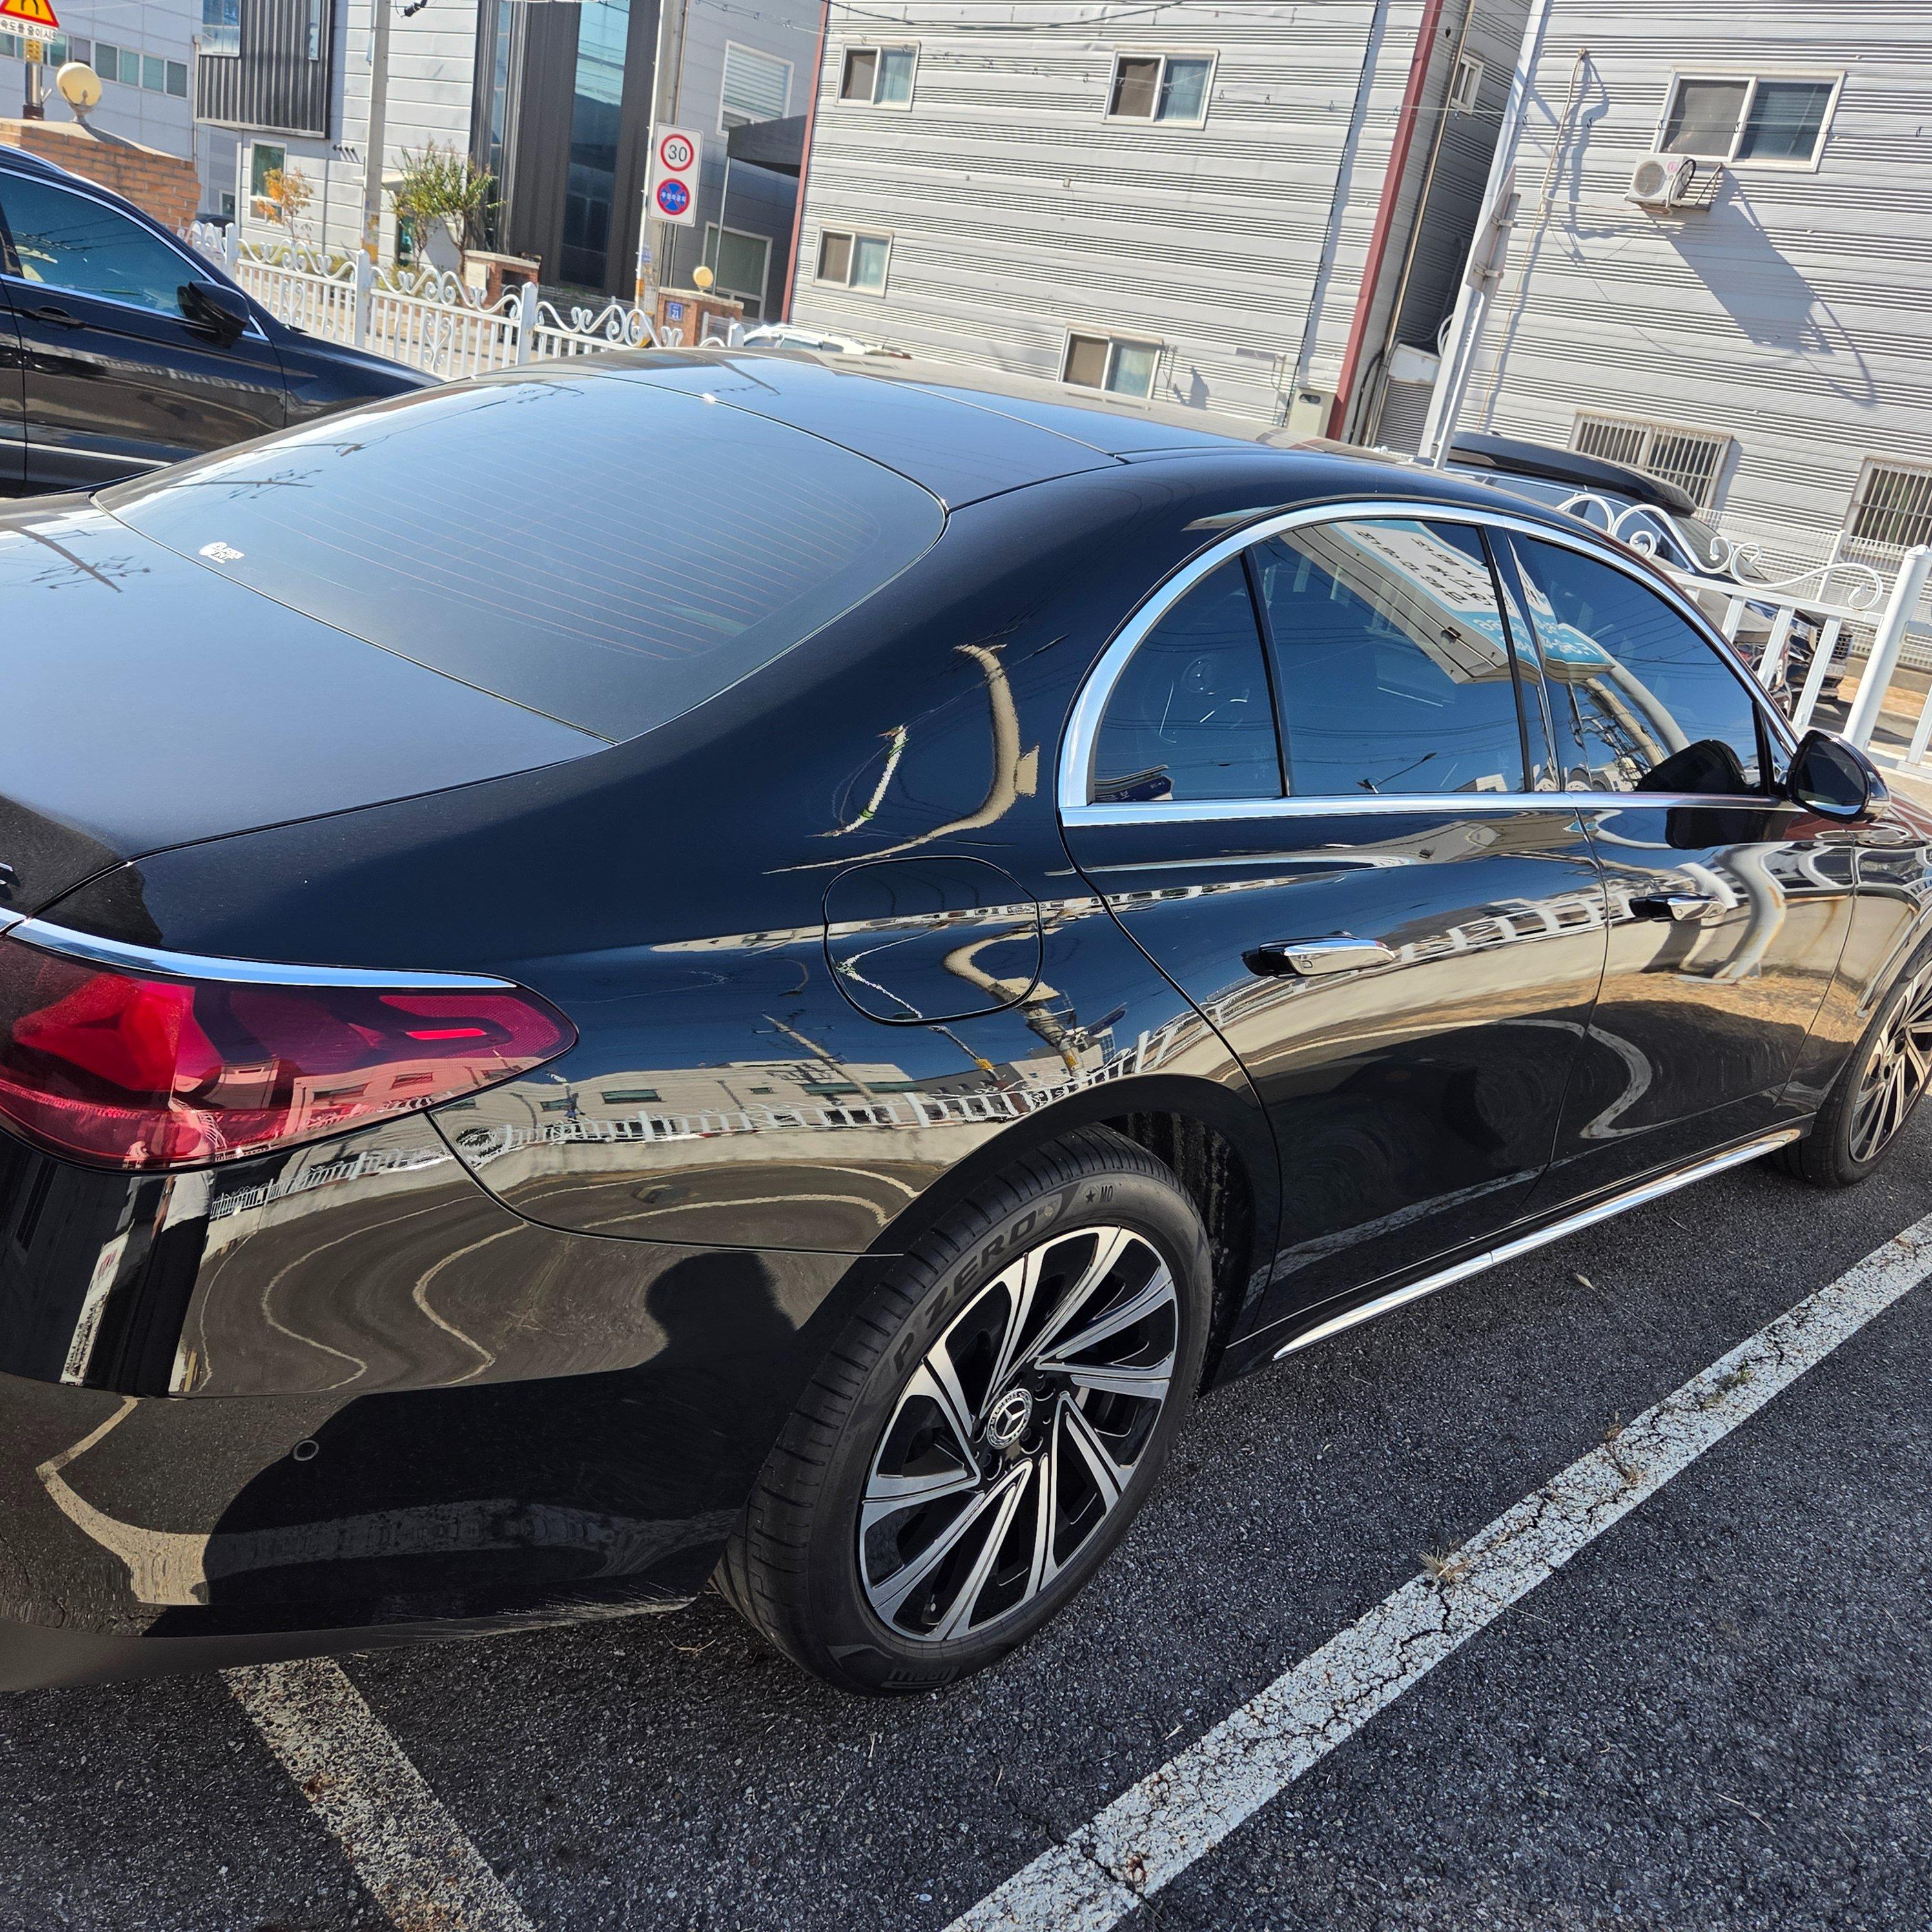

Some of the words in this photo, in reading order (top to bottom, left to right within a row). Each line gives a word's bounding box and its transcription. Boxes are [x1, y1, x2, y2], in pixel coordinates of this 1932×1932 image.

[1, 19, 25, 34] 속도를
[668, 144, 688, 162] 30
[672, 309, 679, 318] 21
[1099, 1185, 1113, 1203] MO
[894, 1331, 915, 1374] P
[925, 1210, 1037, 1330] ZERO
